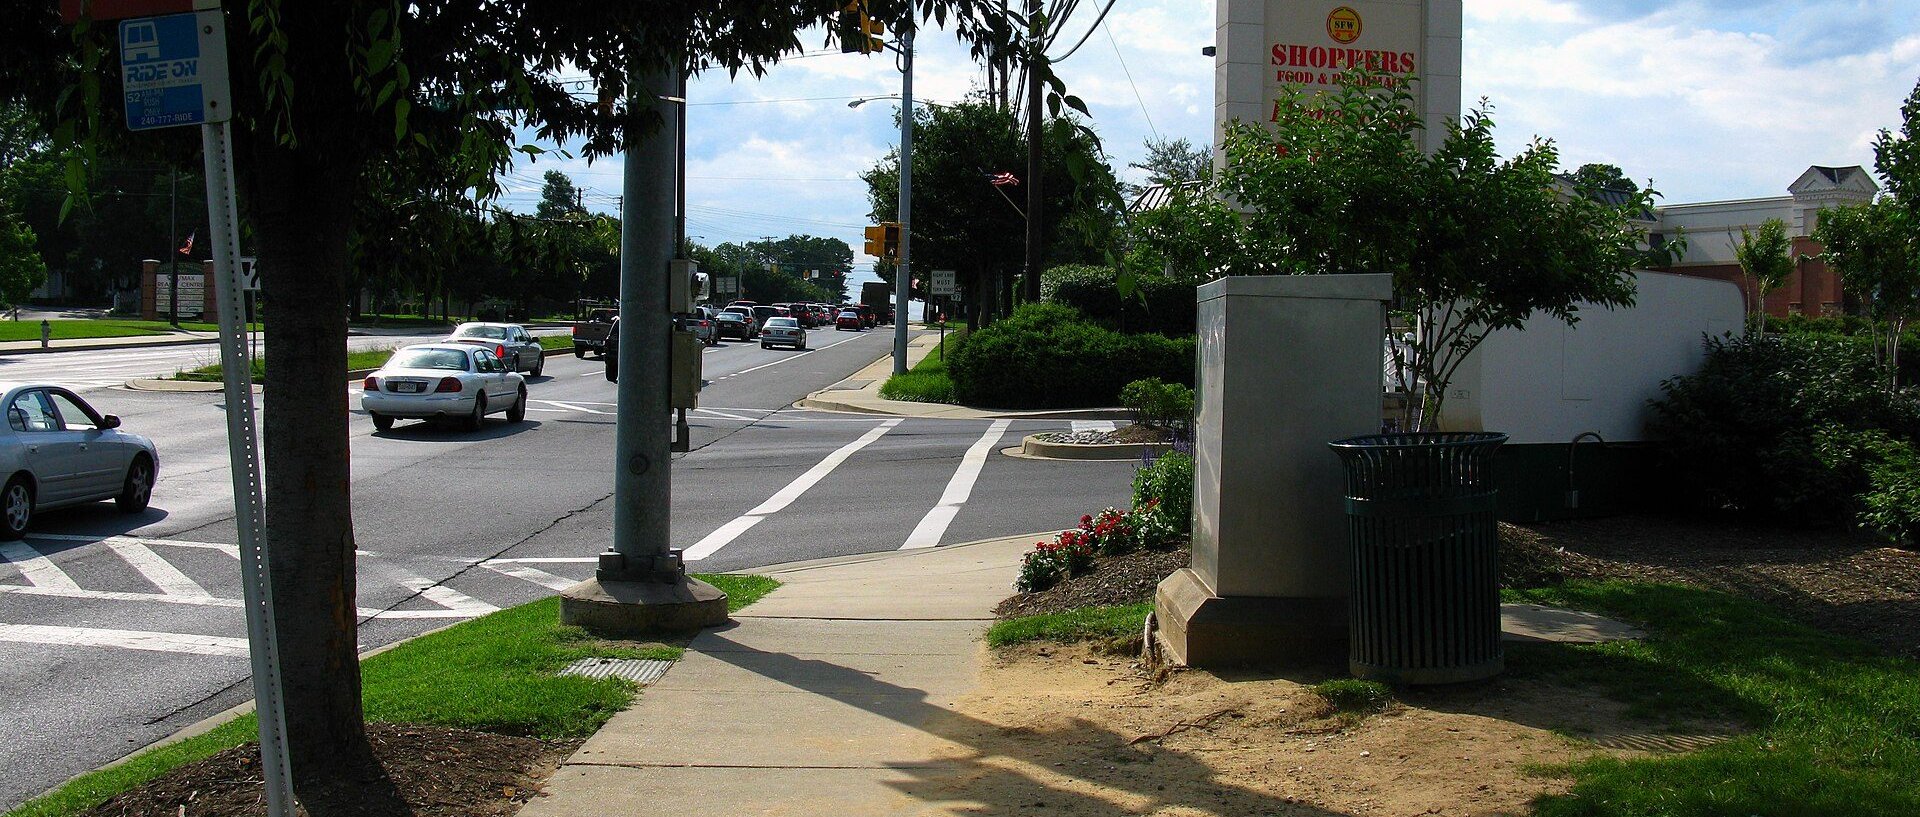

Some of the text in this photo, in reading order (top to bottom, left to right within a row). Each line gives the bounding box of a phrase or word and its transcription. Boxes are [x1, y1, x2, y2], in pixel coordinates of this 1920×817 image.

[1334, 20, 1354, 30] SFW
[1271, 43, 1415, 73] SHOPPERS
[172, 60, 197, 77] ON
[1277, 70, 1314, 84] FOOD
[1317, 72, 1328, 85] &
[127, 92, 141, 103] 52
[141, 112, 193, 125] 240-777-RIDE
